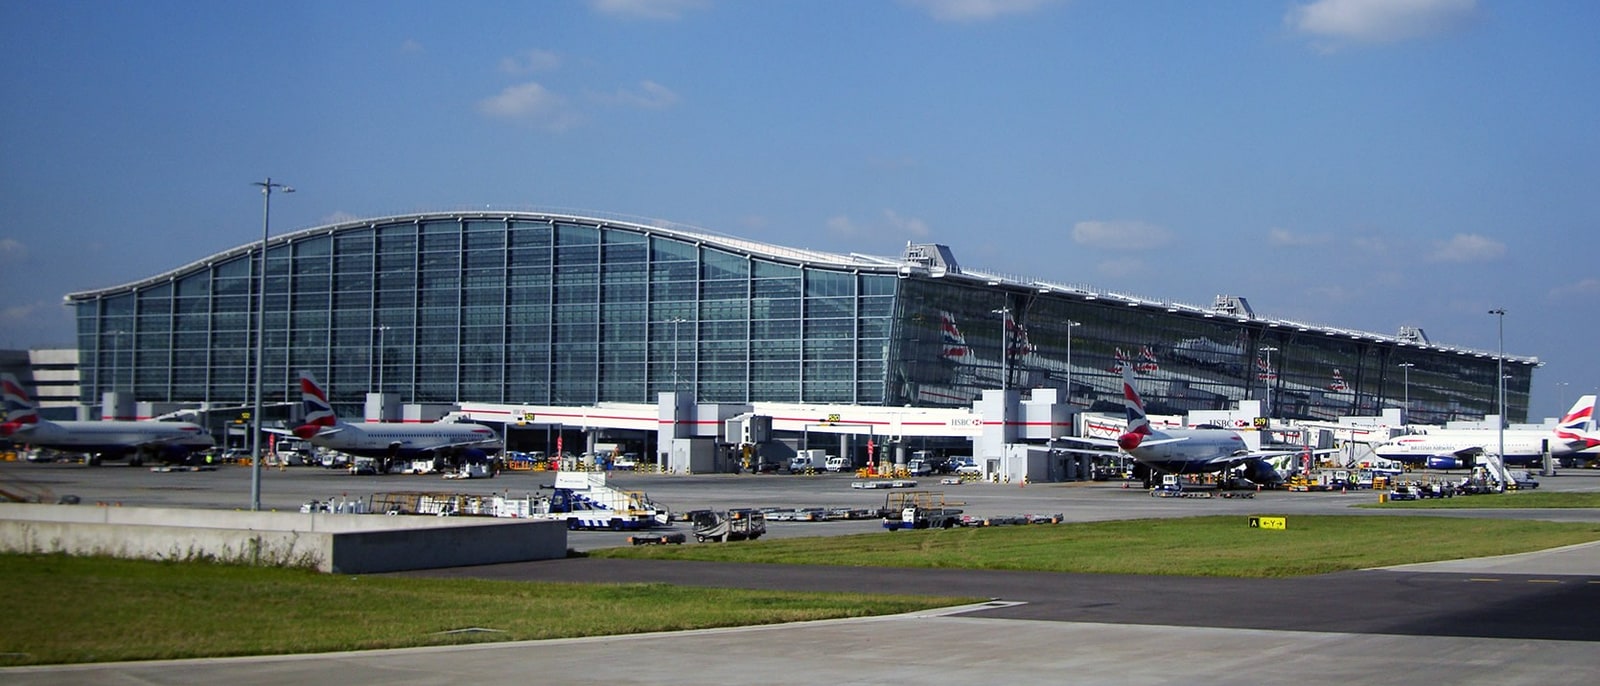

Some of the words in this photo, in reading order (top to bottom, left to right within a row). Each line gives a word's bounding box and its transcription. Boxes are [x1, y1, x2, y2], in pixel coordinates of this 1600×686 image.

[1209, 419, 1233, 427] HSBC
[1254, 418, 1265, 426] 519
[1251, 519, 1258, 527] A
